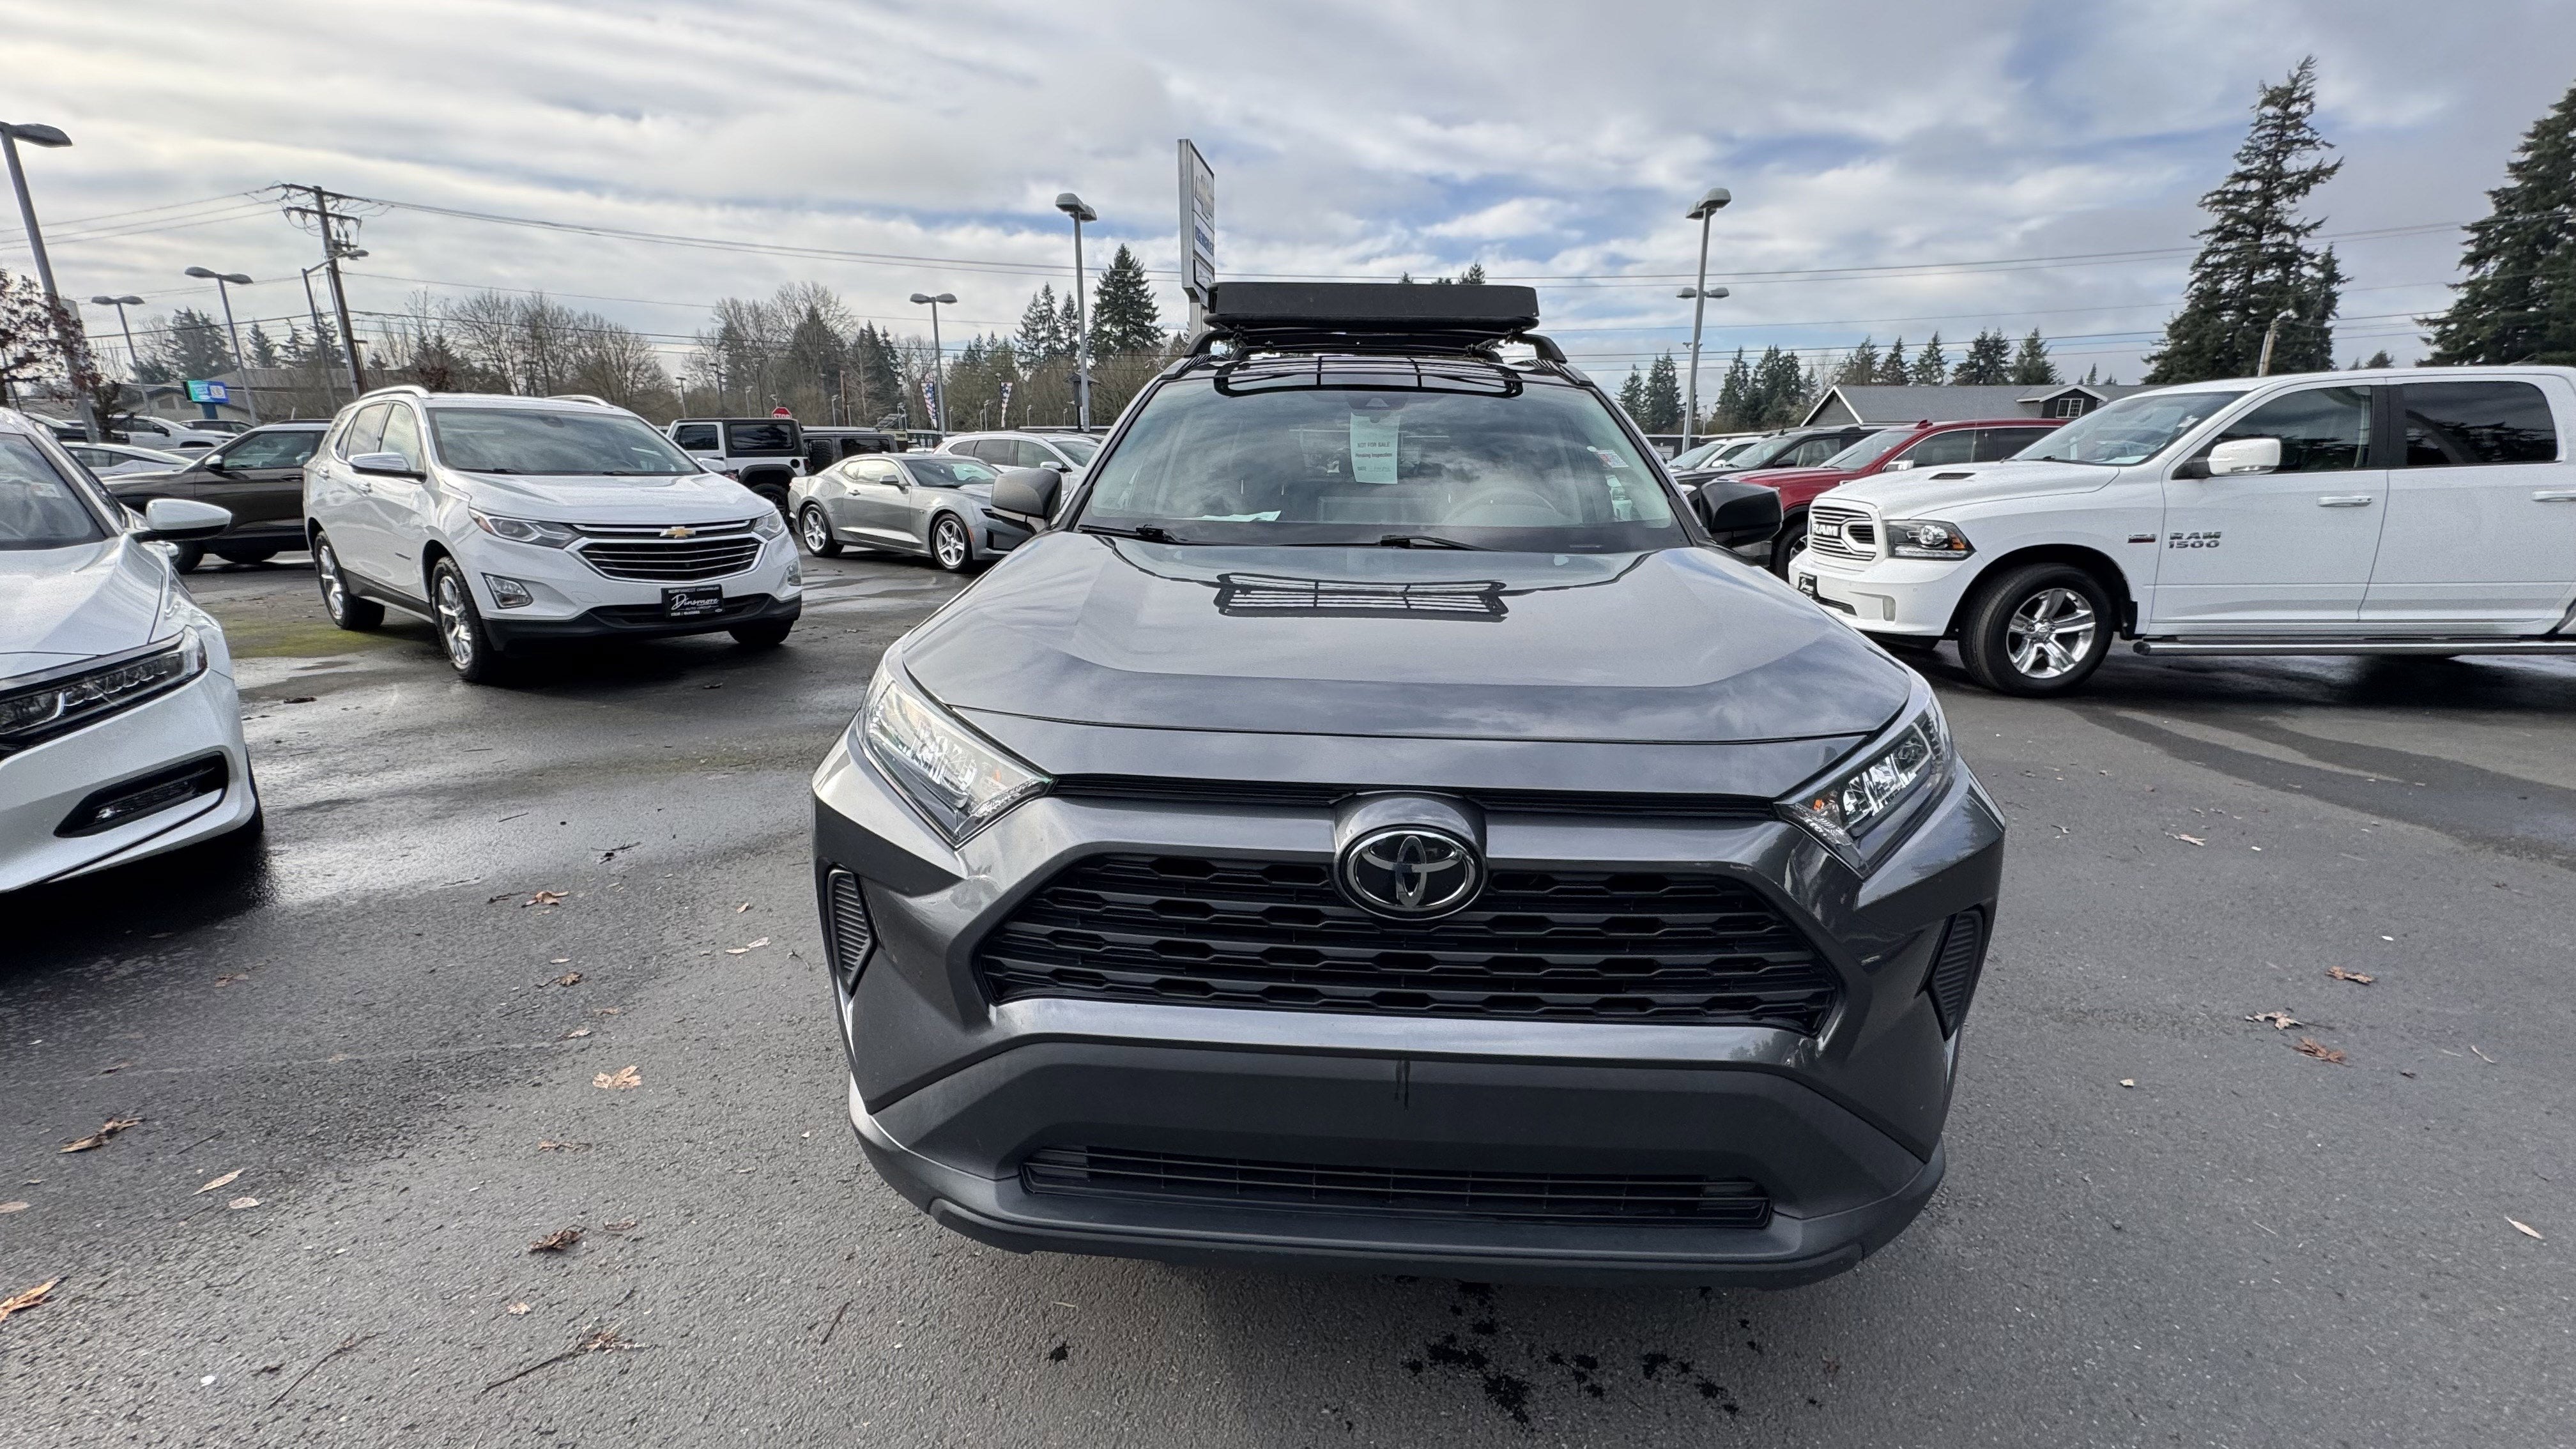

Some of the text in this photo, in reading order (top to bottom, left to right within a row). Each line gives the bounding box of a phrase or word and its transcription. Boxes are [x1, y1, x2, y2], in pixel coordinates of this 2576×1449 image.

[1813, 524, 1838, 536] RAM
[2169, 532, 2221, 540] RAM
[2169, 540, 2220, 549] 1500
